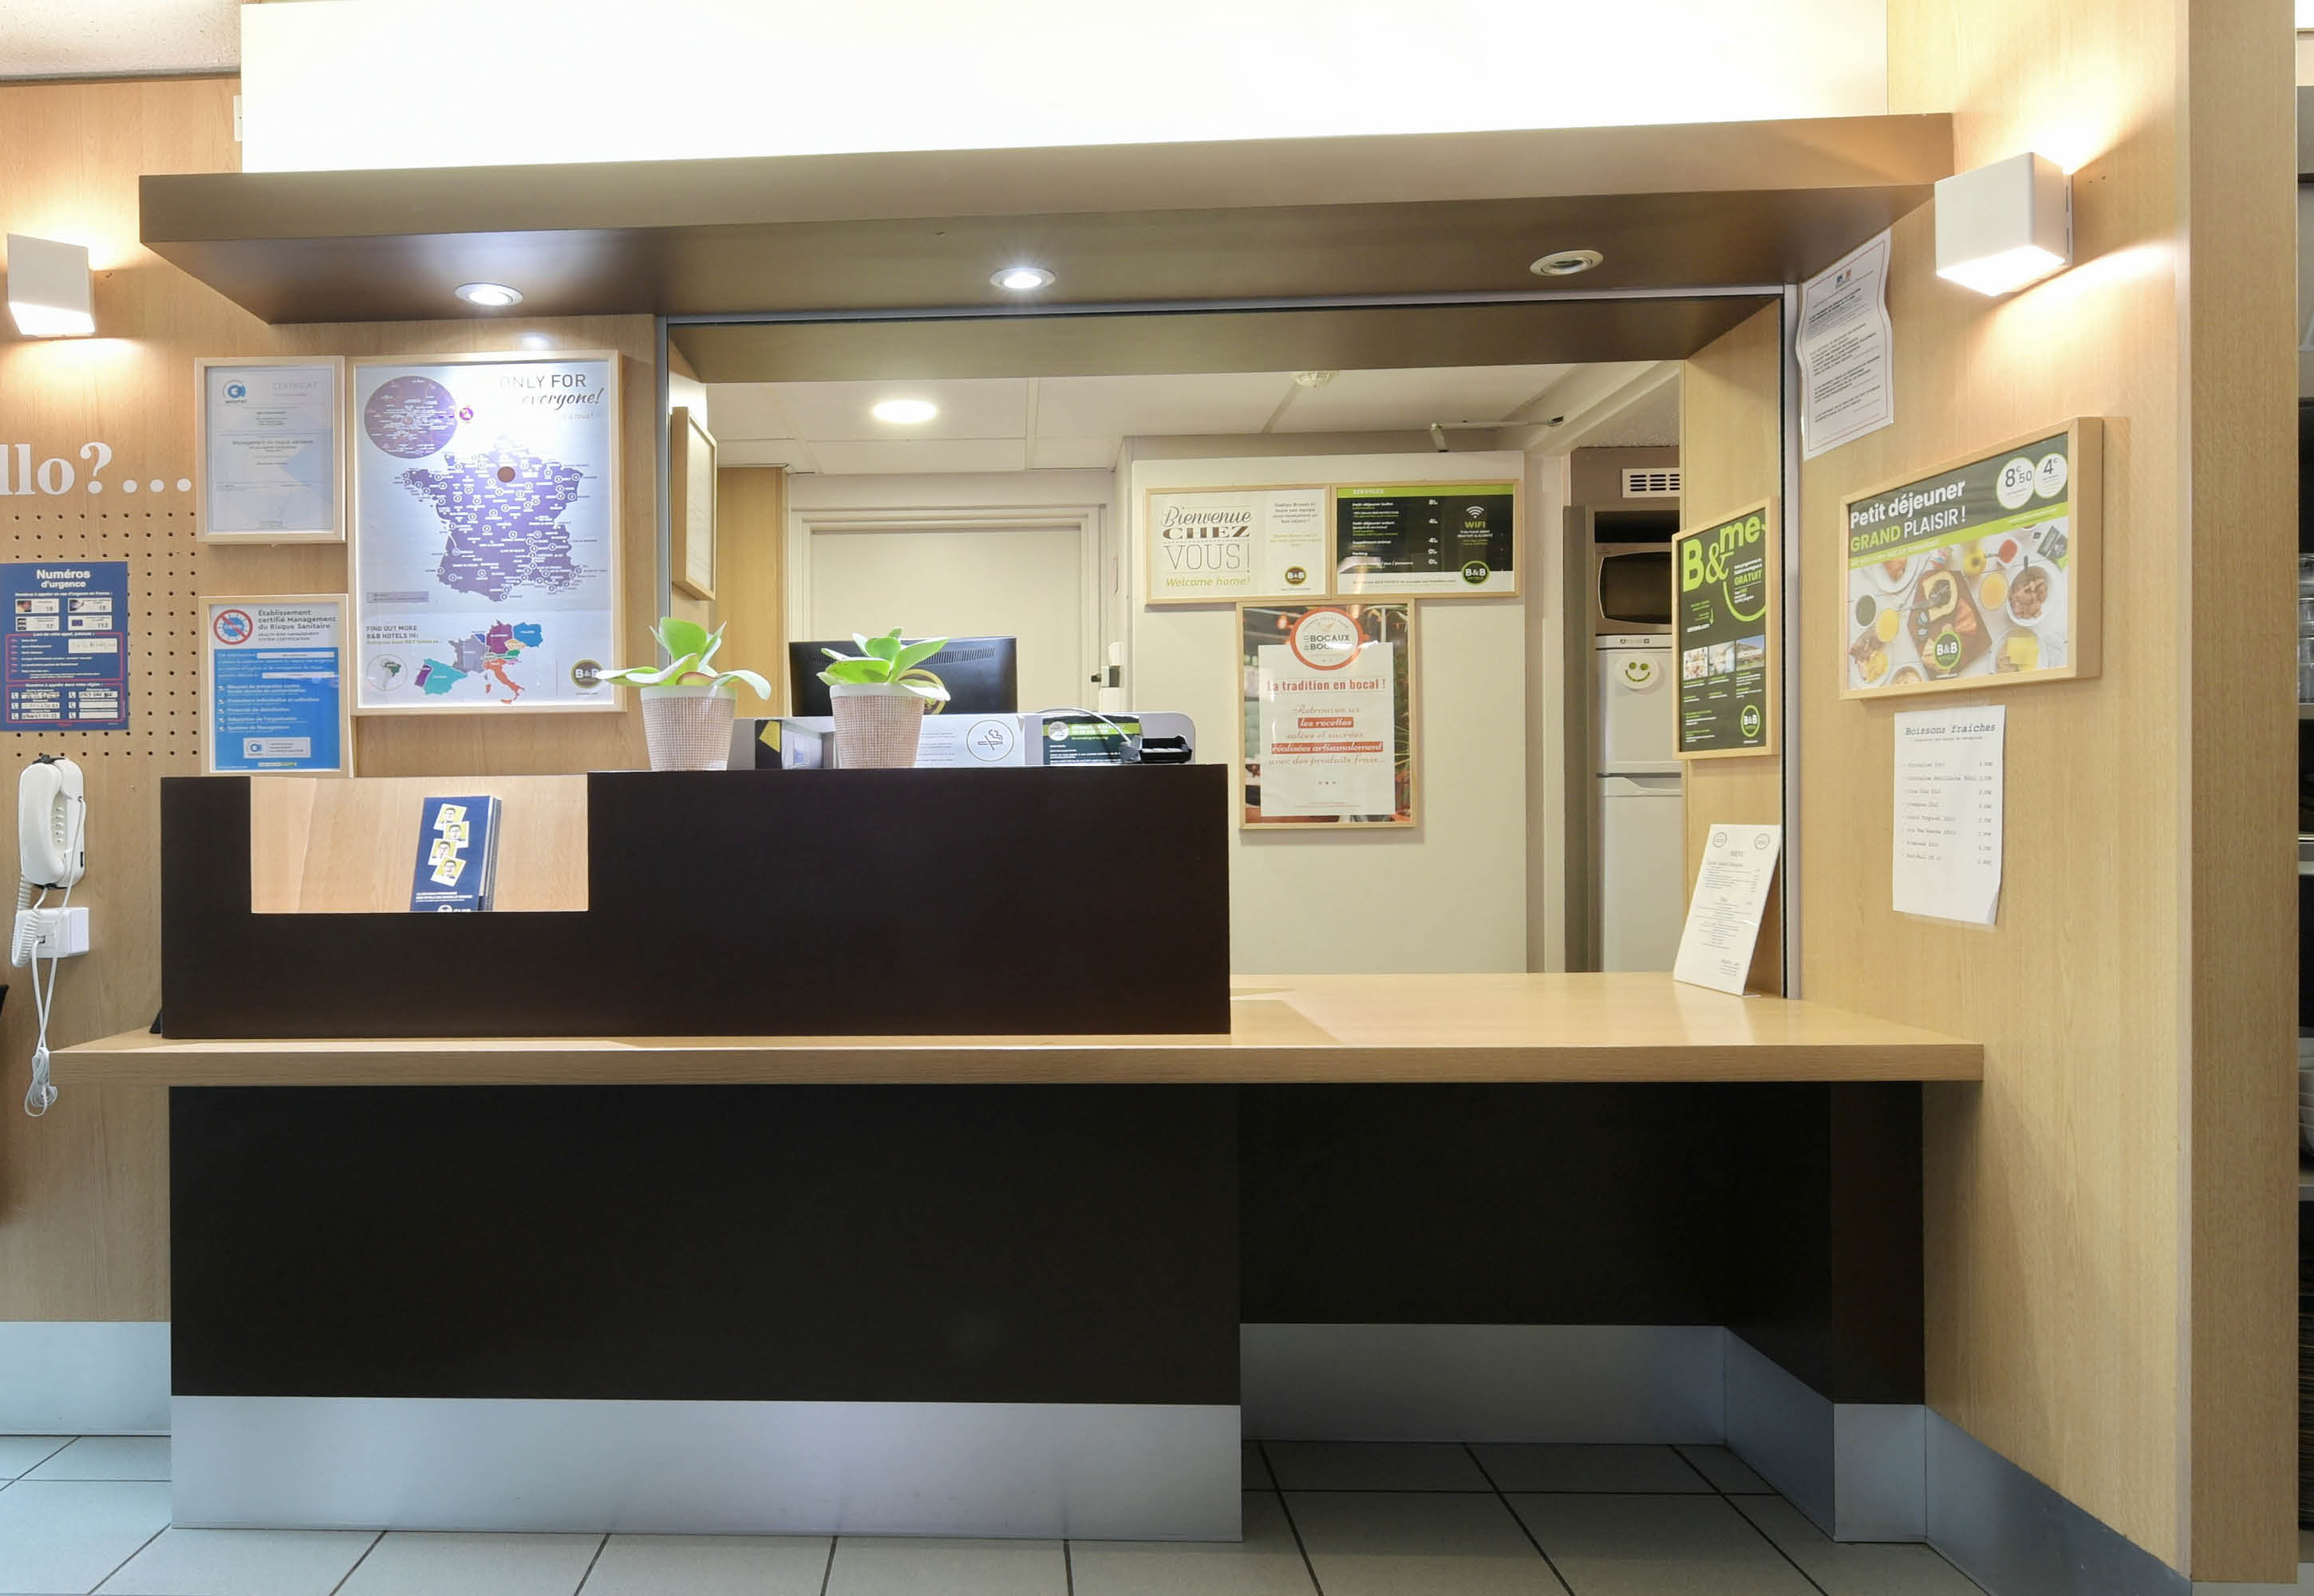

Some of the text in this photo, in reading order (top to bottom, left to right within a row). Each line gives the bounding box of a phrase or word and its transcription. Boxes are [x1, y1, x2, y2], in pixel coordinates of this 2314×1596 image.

[551, 373, 586, 388] FOR
[522, 387, 605, 410] eryone!
[1850, 480, 1966, 529] Petit déjeuner
[1162, 506, 1253, 527] Bienvenue
[1163, 526, 1250, 539] CHEZ
[1850, 525, 1901, 552] GRAND
[1904, 508, 1958, 539] PLAISIR
[36, 568, 91, 579] Numéros
[1465, 567, 1487, 577] B&B
[41, 580, 86, 590] d'urgence
[1166, 575, 1251, 587] Welcome home!
[1309, 634, 1350, 642] BOCAUX
[1936, 641, 1958, 657] B&B
[1266, 680, 1278, 691] La
[1282, 680, 1330, 691] tradition
[1333, 681, 1346, 690] en
[1349, 678, 1379, 690] bocal
[1316, 717, 1352, 727] recettes
[1272, 741, 1383, 753] réalisées artisanalement
